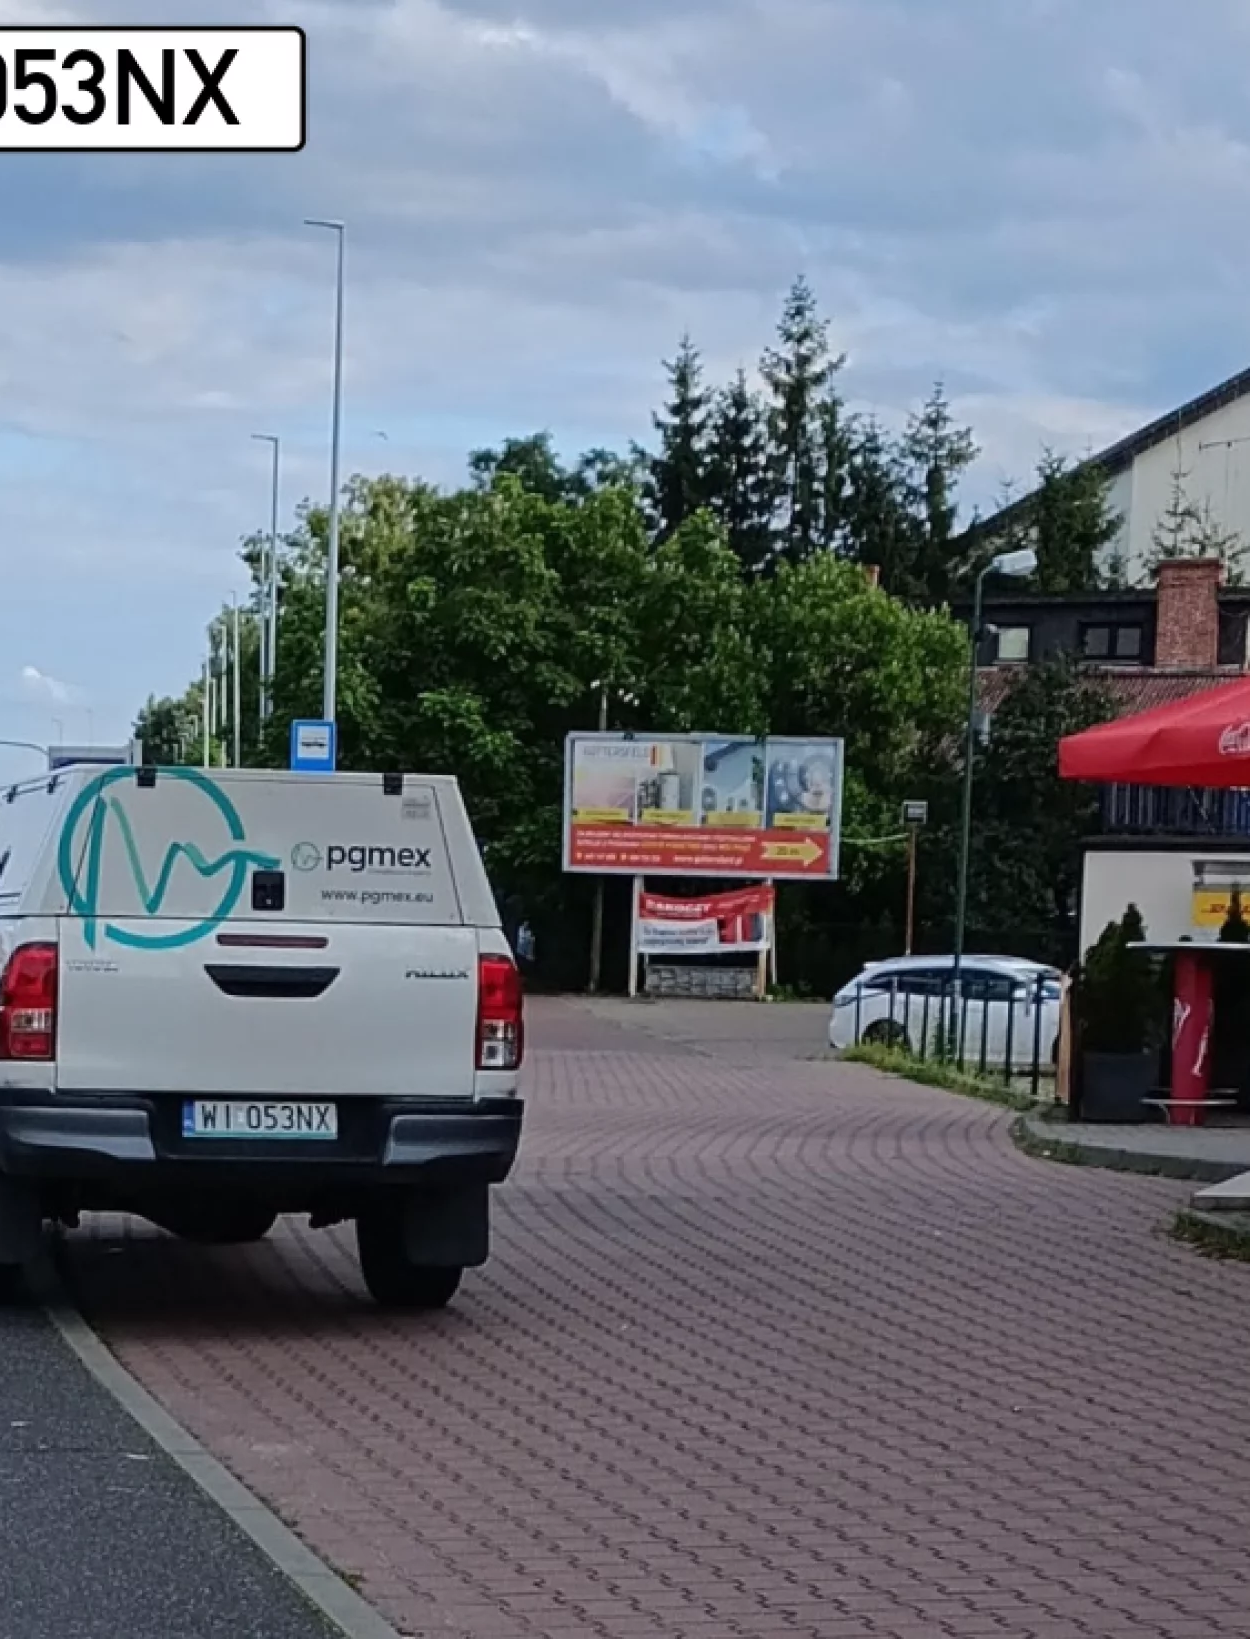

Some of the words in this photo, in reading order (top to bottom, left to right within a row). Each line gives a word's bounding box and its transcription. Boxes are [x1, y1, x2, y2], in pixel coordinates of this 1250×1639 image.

[326, 845, 432, 872] pgmex
[321, 889, 434, 905] www.pgmex.eu
[201, 1103, 232, 1129] WI
[245, 1104, 331, 1131] 053NX
